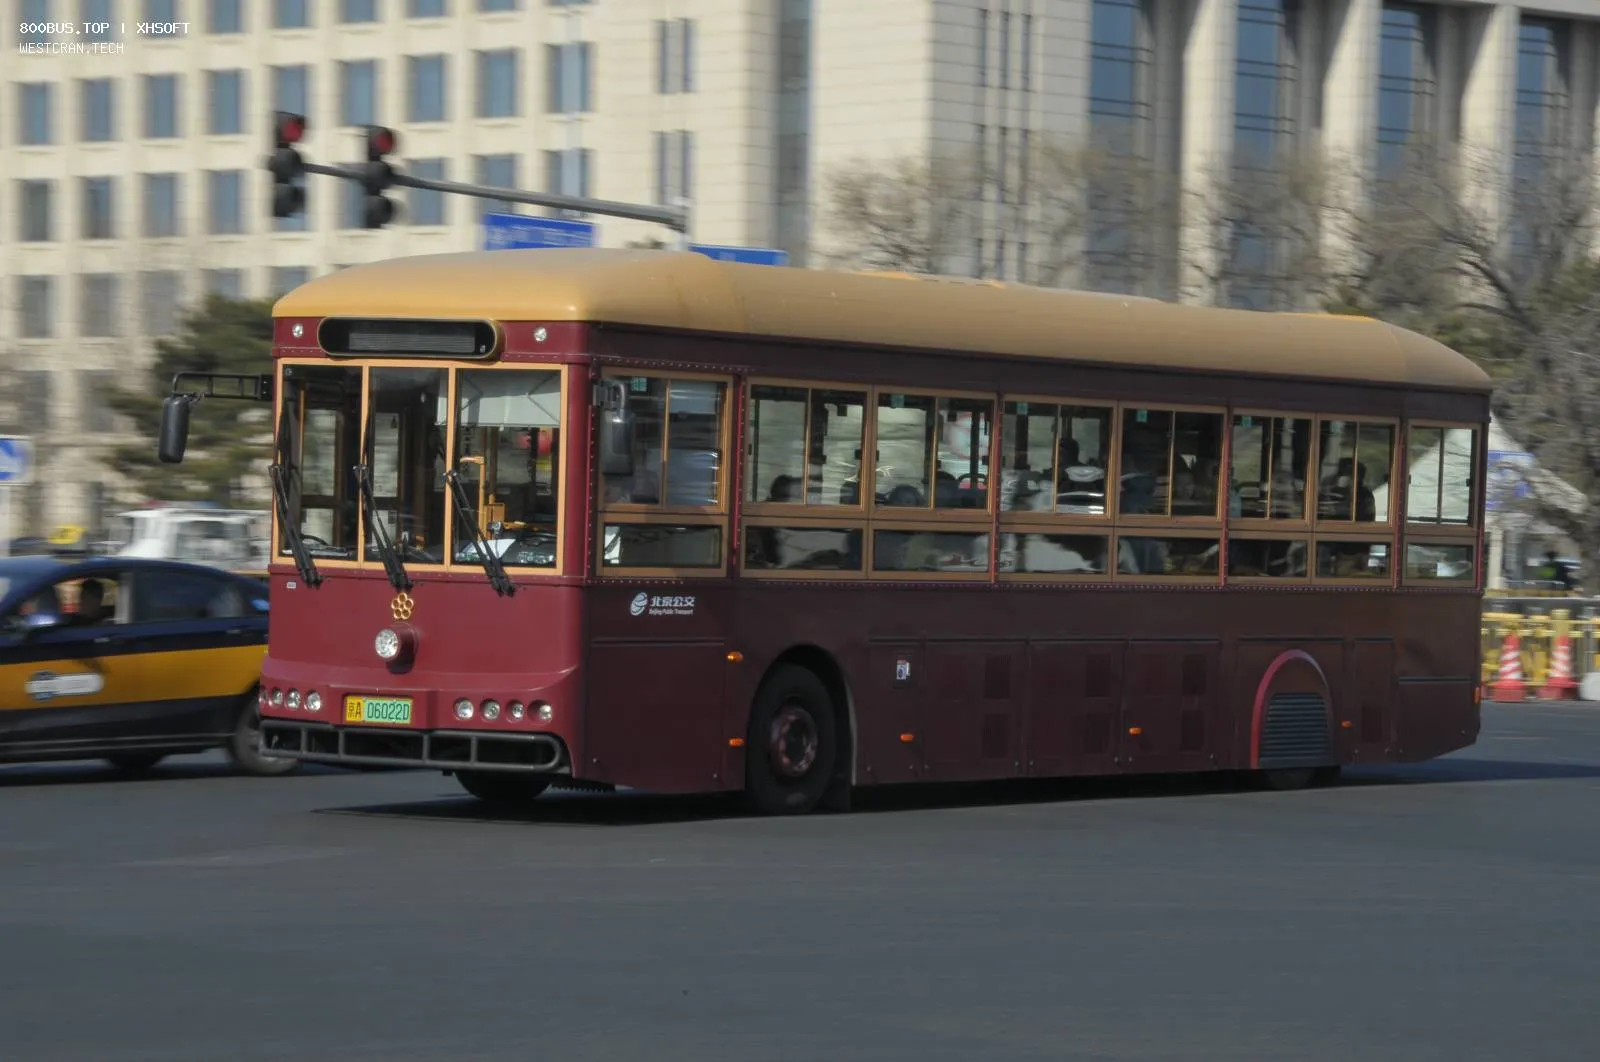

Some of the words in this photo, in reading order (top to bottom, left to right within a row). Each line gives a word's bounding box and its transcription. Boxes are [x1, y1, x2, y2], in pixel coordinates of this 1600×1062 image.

[649, 595, 696, 607] 北京公交
[367, 702, 410, 720] 06022D
